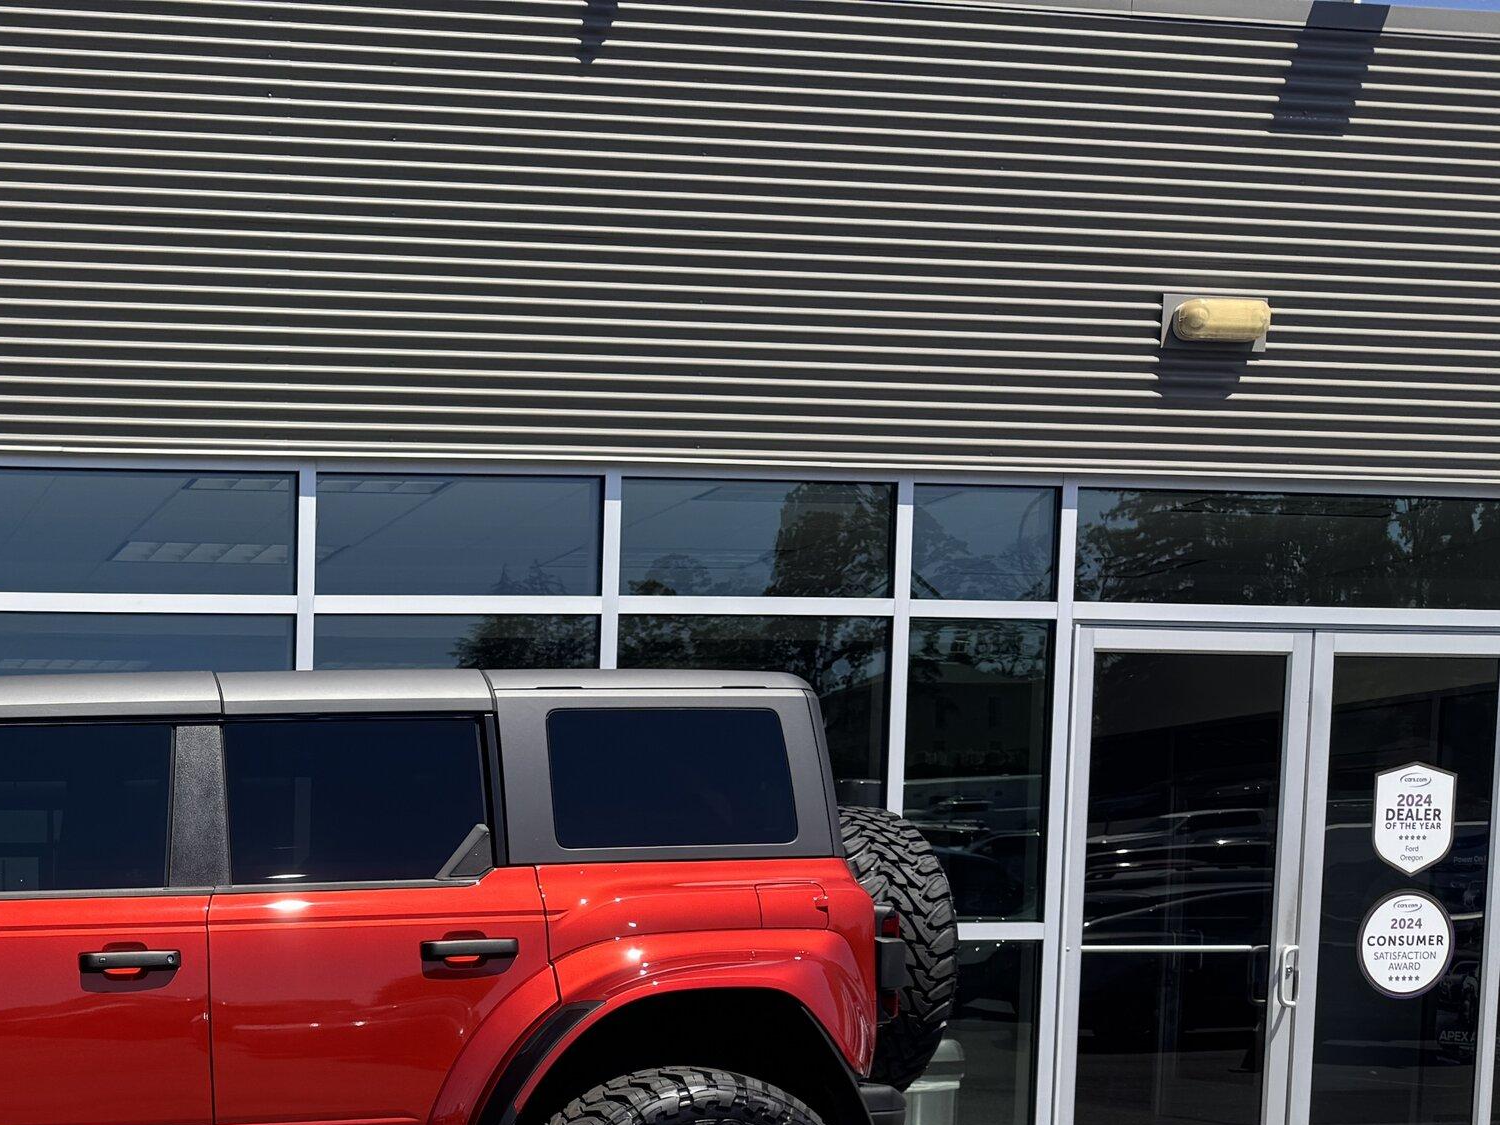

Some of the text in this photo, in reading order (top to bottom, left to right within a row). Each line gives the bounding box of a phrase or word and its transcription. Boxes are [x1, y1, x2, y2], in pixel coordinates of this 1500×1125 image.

[1396, 793, 1432, 807] 2024
[1385, 808, 1442, 821] DEALER
[1385, 822, 1442, 830] OF THE YEAR
[1400, 854, 1424, 863] Oregon
[1390, 918, 1422, 929] 2024
[1367, 935, 1444, 946] CONSUMER
[1373, 951, 1437, 960] SATISFACTION
[1388, 962, 1421, 970] AWARD
[1439, 1030, 1469, 1042] APEX
